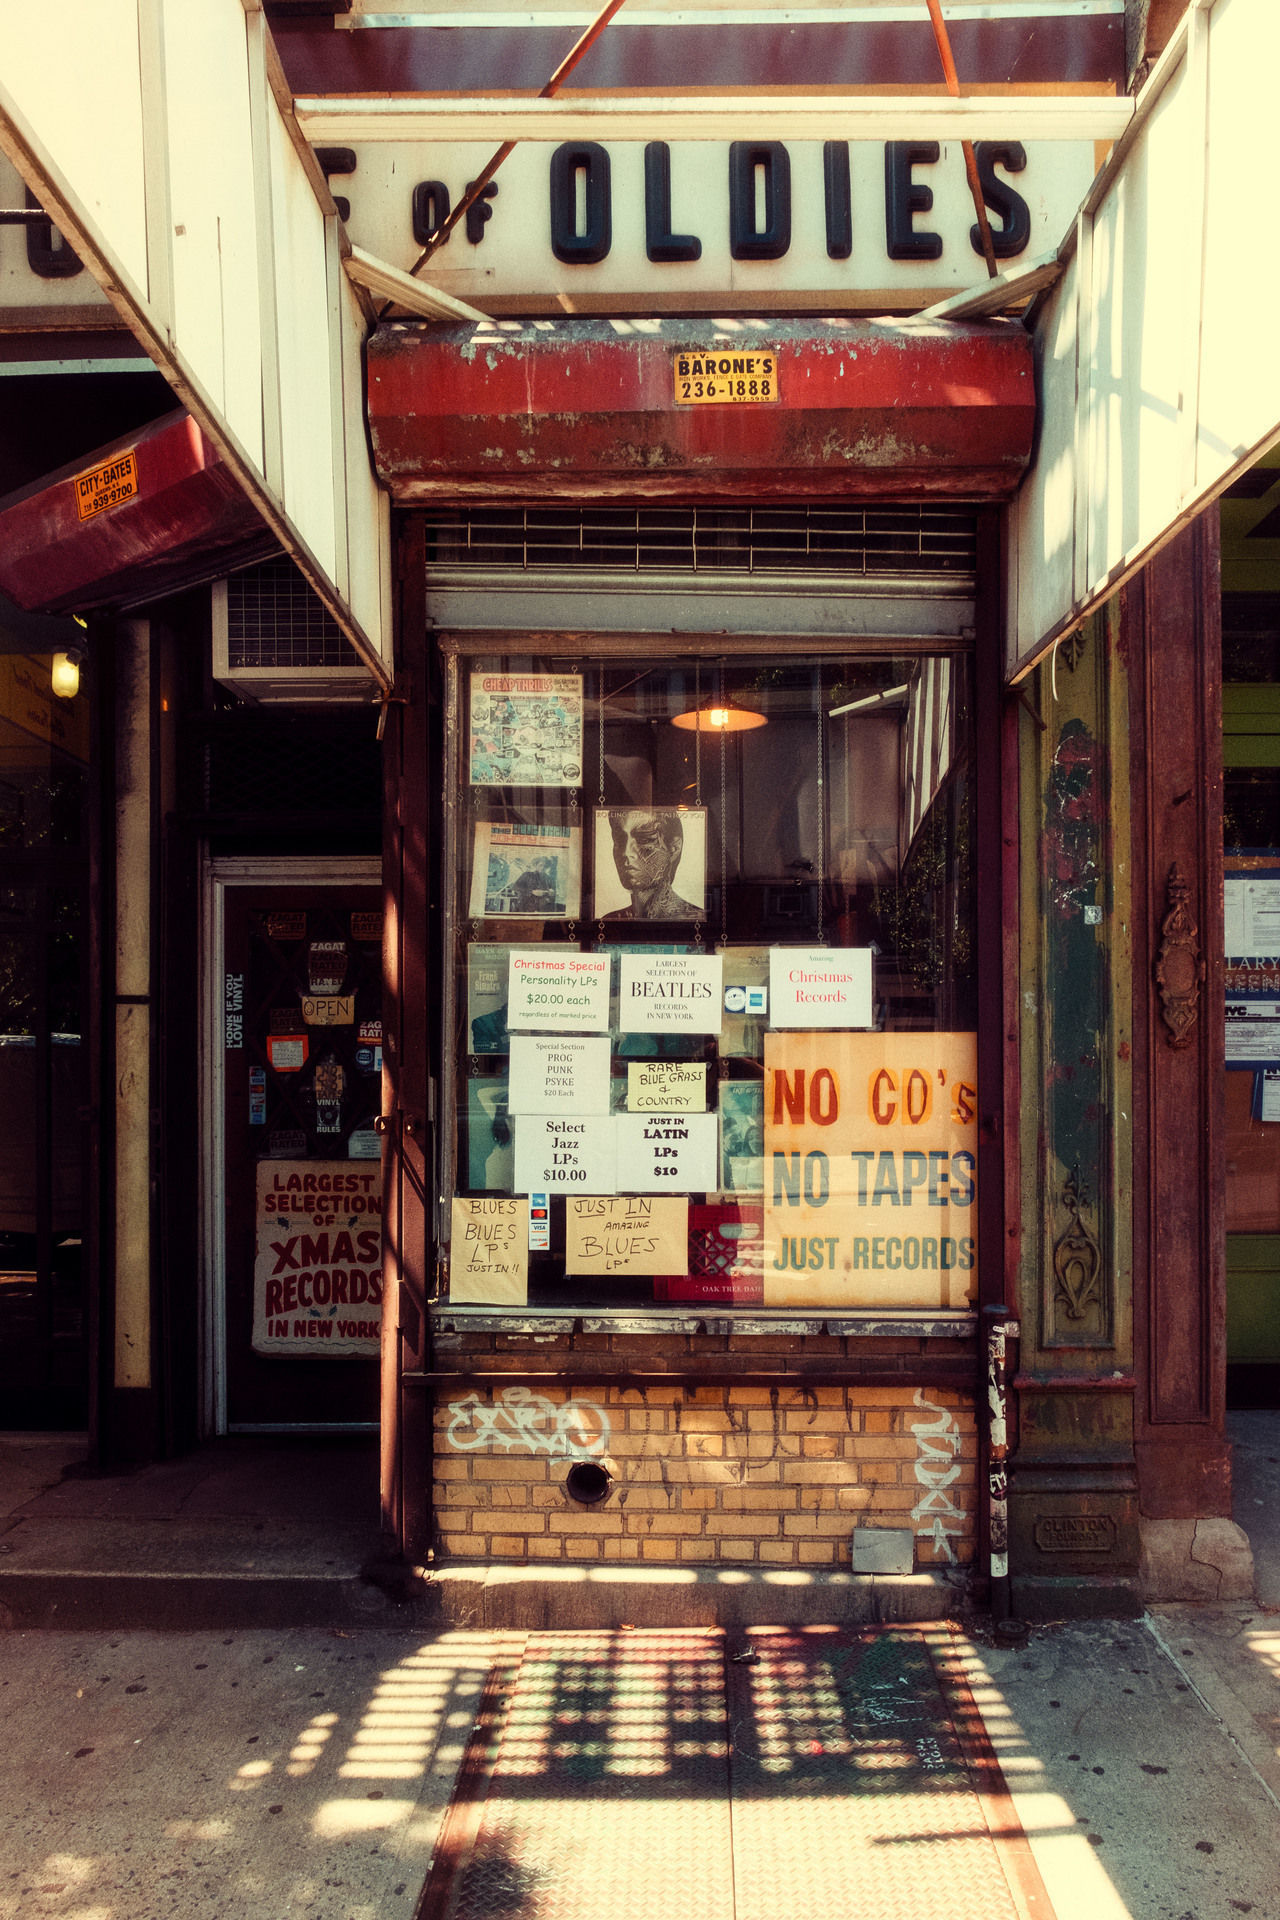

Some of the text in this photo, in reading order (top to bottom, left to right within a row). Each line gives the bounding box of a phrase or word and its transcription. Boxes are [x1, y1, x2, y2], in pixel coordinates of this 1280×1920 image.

[412, 181, 498, 247] OF
[550, 141, 1031, 264] OLDIES
[679, 358, 773, 376] BARONE'S
[681, 380, 770, 398] 236-1888
[93, 482, 133, 510] 939-9700
[483, 677, 515, 692] CHEAP
[515, 677, 553, 693] THRILLS
[353, 912, 382, 922] ZAGA
[310, 942, 344, 951] ZAGAT
[514, 959, 605, 973] Christmas Special
[656, 960, 687, 968] LARGEST
[646, 969, 686, 977] SELECTION
[788, 969, 853, 983] Christmas
[520, 974, 598, 988] Personality LPs
[631, 981, 712, 998] BEATLES
[795, 989, 847, 1003] Records
[527, 993, 590, 1005] $20.00 each
[226, 974, 234, 1049] HONK IF YOU
[233, 973, 243, 1049] LOVE VINYL
[303, 1000, 349, 1017] OPEN
[654, 1003, 688, 1011] RECORDS
[518, 1011, 549, 1019] regardless
[674, 1012, 693, 1020] YORK
[535, 1042, 585, 1051] Special Section
[547, 1053, 573, 1062] PROG
[547, 1065, 573, 1074] PUNK
[645, 1063, 684, 1073] RARE
[545, 1077, 575, 1087] PSYKE
[639, 1071, 704, 1086] BLUE GRASS
[544, 1089, 575, 1097] $20 Each
[772, 1068, 839, 1126] NO
[637, 1096, 692, 1107] COUNTRY
[546, 1120, 586, 1133] Select
[648, 1117, 685, 1126] JUST IN
[643, 1128, 689, 1140] LATIN
[551, 1137, 580, 1149] Jazz
[553, 1153, 579, 1165] LPs
[654, 1147, 678, 1158] LPs
[543, 1169, 587, 1182] $10.00
[654, 1165, 678, 1177] $10
[273, 1173, 376, 1193] LARGEST
[772, 1150, 976, 1208] NO TAPES
[264, 1193, 382, 1214] SELECTION
[469, 1200, 518, 1215] BLUES
[573, 1198, 652, 1218] JUST IN
[312, 1214, 336, 1227] OF
[604, 1221, 650, 1232] AMAZING
[465, 1223, 517, 1241] BLUES
[269, 1230, 381, 1276] XMAS
[577, 1236, 661, 1257] BLUES
[773, 1236, 975, 1271] JUST RECORDS
[265, 1268, 382, 1318] RECORDS
[267, 1319, 381, 1339] IN NEW YORK
